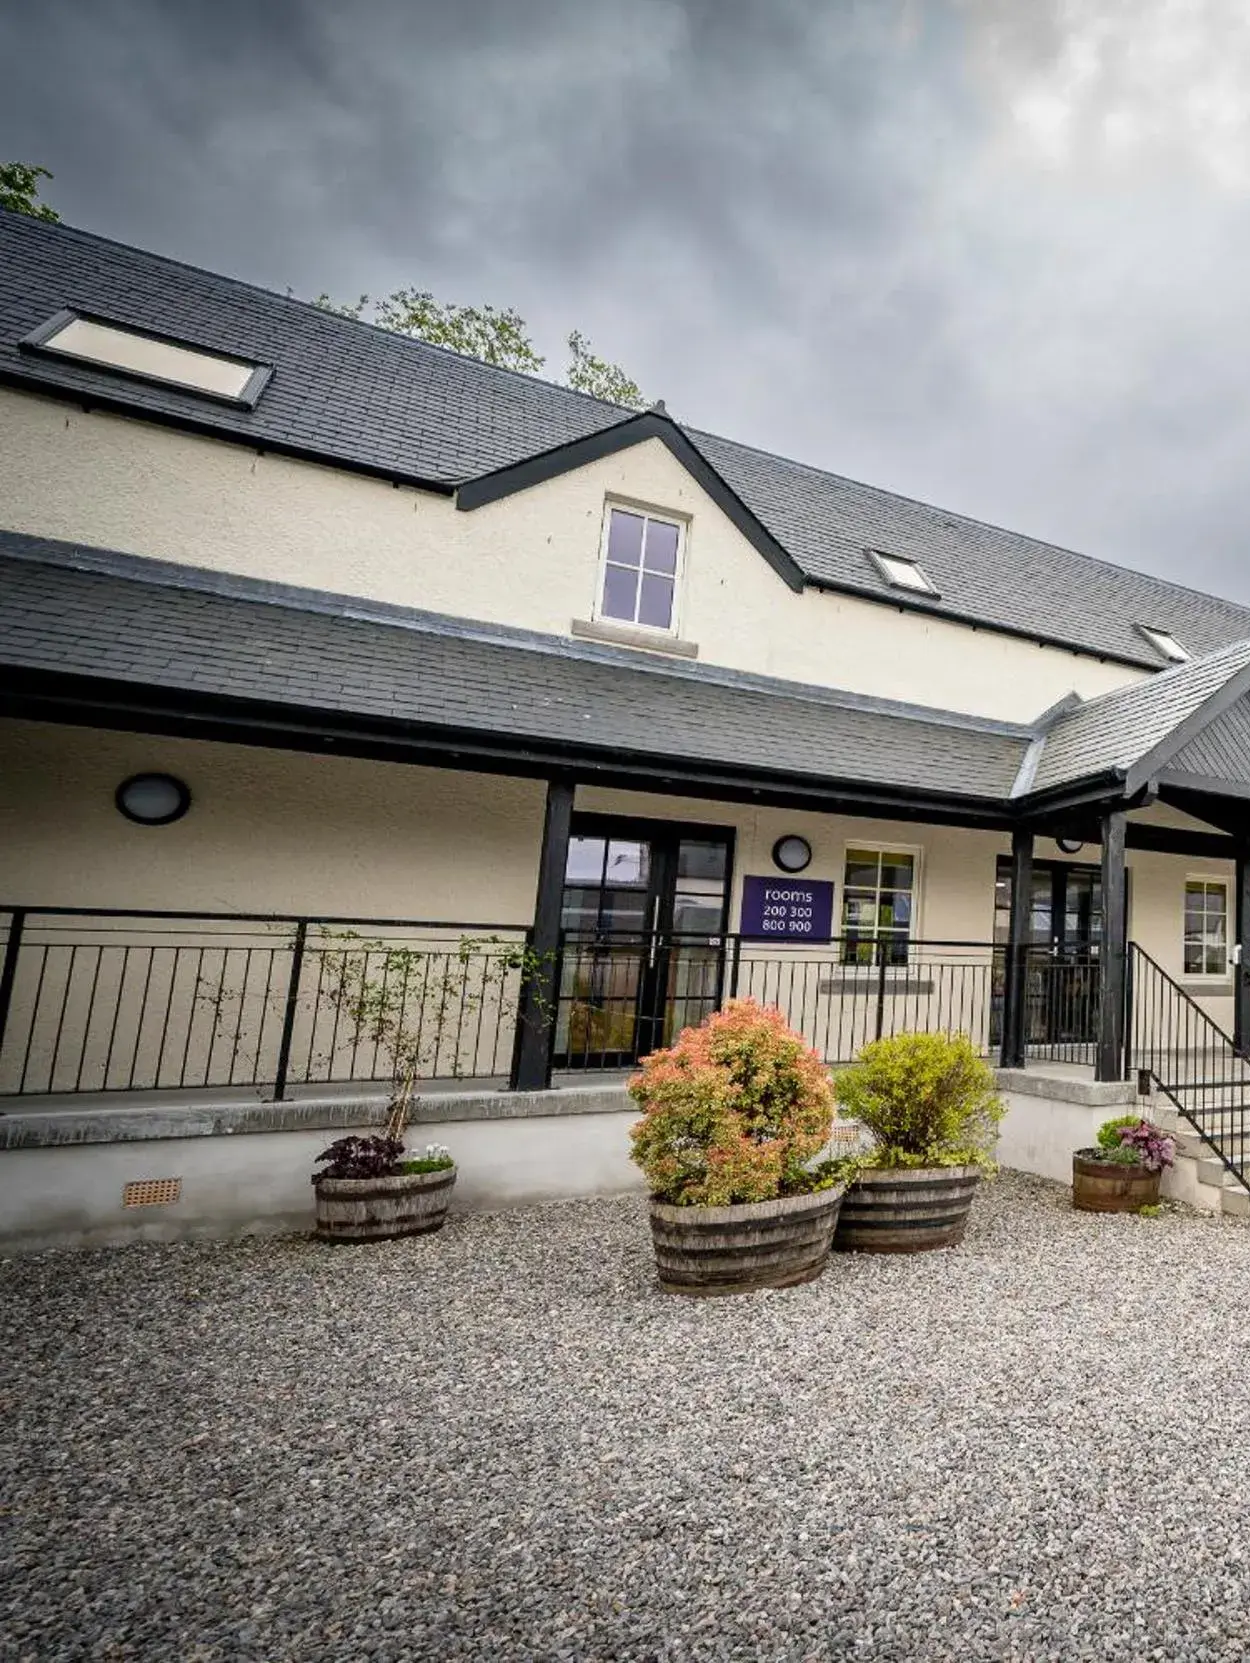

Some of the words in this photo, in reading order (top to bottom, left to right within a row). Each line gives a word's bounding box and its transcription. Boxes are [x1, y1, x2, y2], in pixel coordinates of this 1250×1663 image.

[765, 889, 813, 902] rooms
[763, 905, 787, 917] 200
[789, 906, 812, 918] 300
[789, 920, 812, 932] 900
